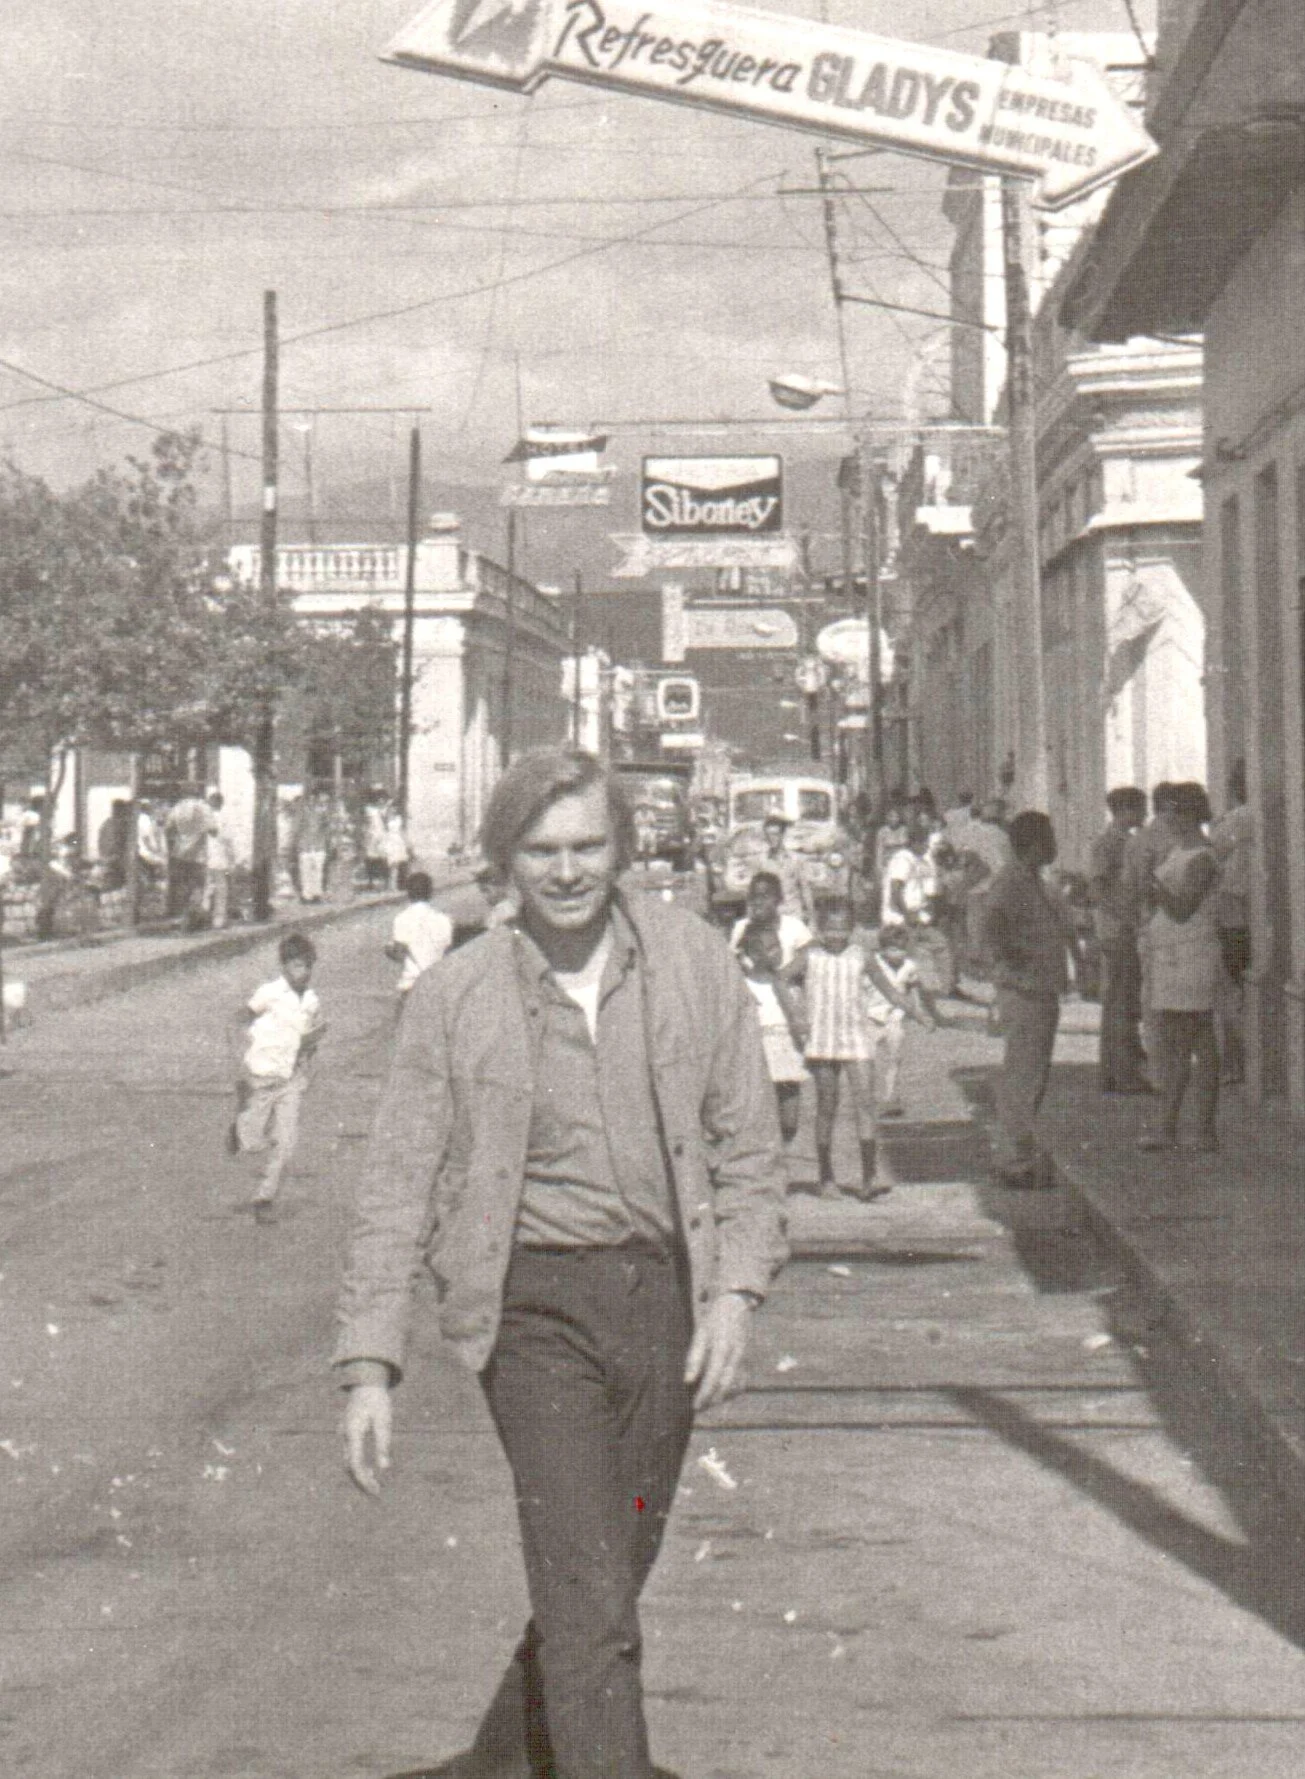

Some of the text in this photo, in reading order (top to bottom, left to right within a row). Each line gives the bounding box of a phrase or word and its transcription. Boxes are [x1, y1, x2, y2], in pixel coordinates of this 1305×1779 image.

[553, 0, 980, 132] Refresquera GLADYS
[997, 89, 1098, 129] EMPRESAS
[645, 484, 778, 529] Siboney
